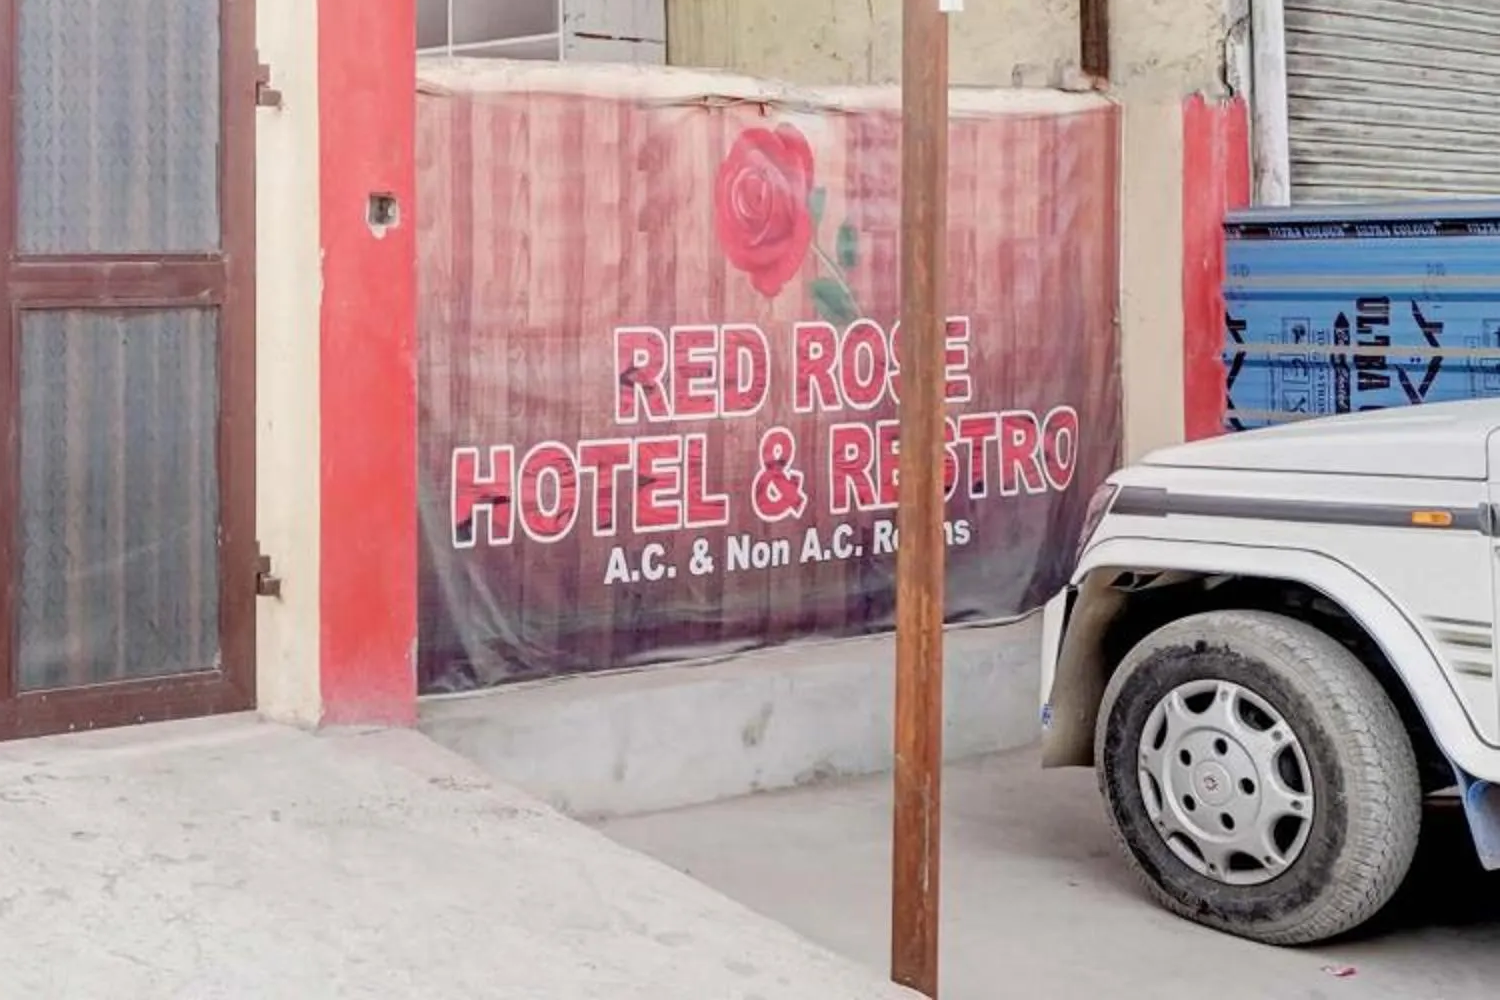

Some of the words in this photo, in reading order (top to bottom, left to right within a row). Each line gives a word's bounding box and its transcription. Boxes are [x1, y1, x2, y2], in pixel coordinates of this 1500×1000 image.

[614, 324, 770, 424] RED
[793, 317, 972, 413] ROE
[452, 433, 729, 548] HOTEL
[752, 426, 807, 522] &
[604, 546, 676, 584] A.C.
[689, 537, 714, 575] &
[726, 534, 789, 572] Non
[800, 522, 863, 564] A.C.
